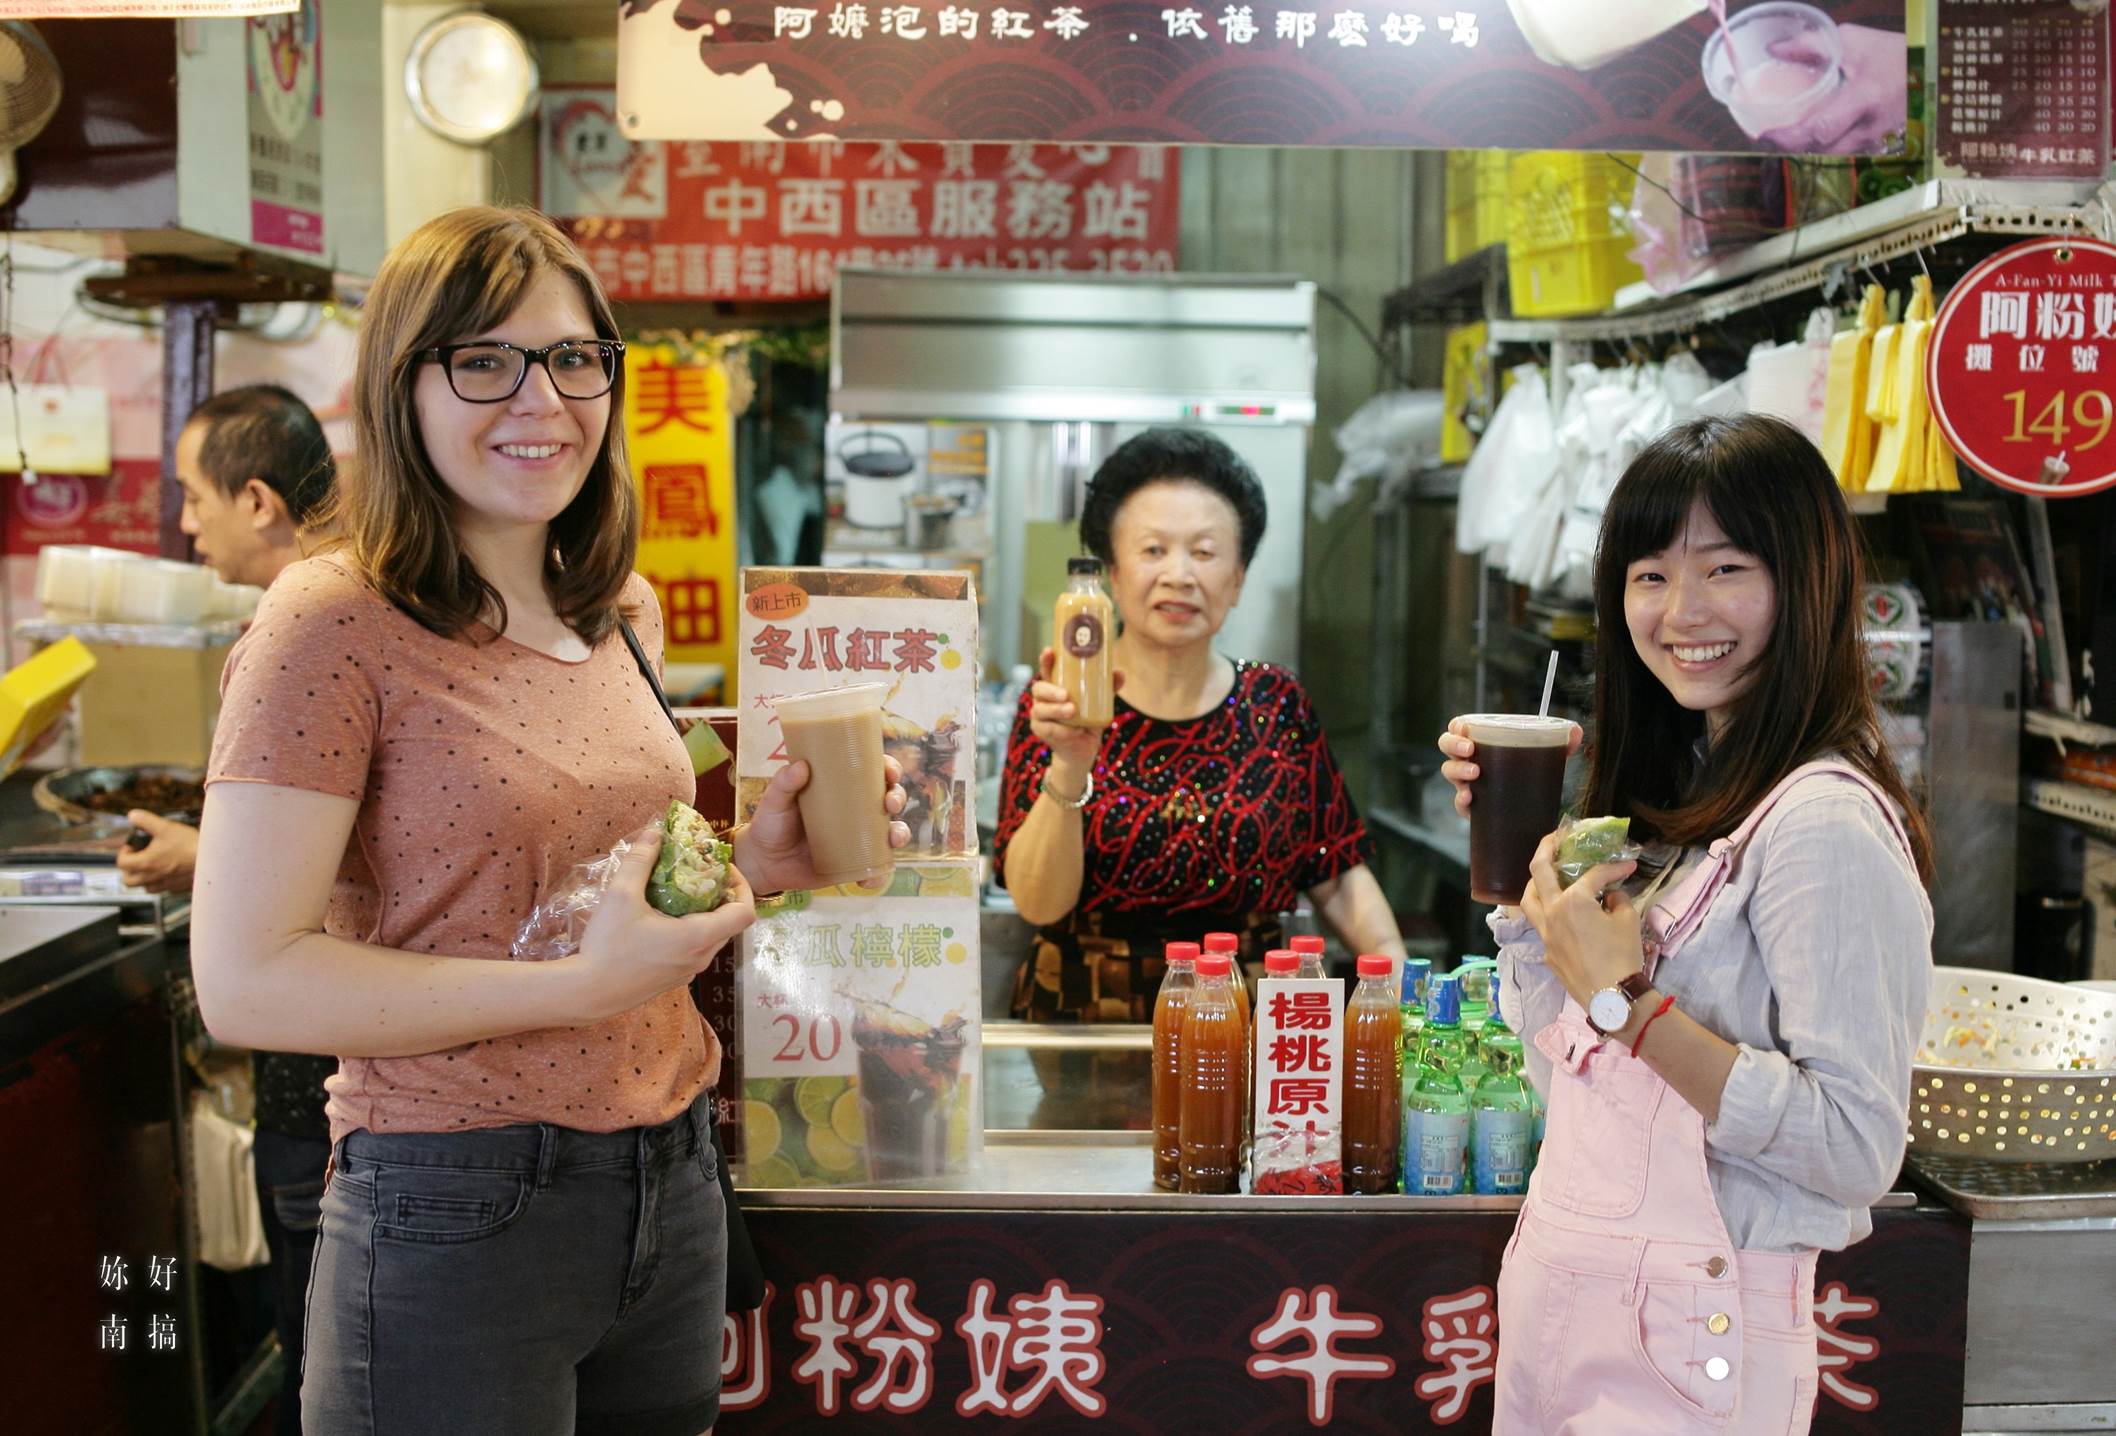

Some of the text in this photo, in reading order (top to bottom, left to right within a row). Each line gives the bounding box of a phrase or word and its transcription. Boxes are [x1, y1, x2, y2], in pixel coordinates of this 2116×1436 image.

[2080, 41, 2096, 51] 10
[2080, 54, 2096, 65] 10
[2080, 67, 2096, 78] 10
[2080, 81, 2096, 92] 10
[704, 177, 1151, 239] 中西區服務站
[1996, 273, 2063, 287] A-Fan-Yi
[2069, 273, 2103, 287] Milk
[2003, 389, 2113, 450] 149
[752, 593, 801, 611] 新上市
[751, 625, 938, 672] 冬瓜紅茶
[772, 1014, 841, 1062] 20
[1268, 991, 1332, 1157] 楊桃原汁
